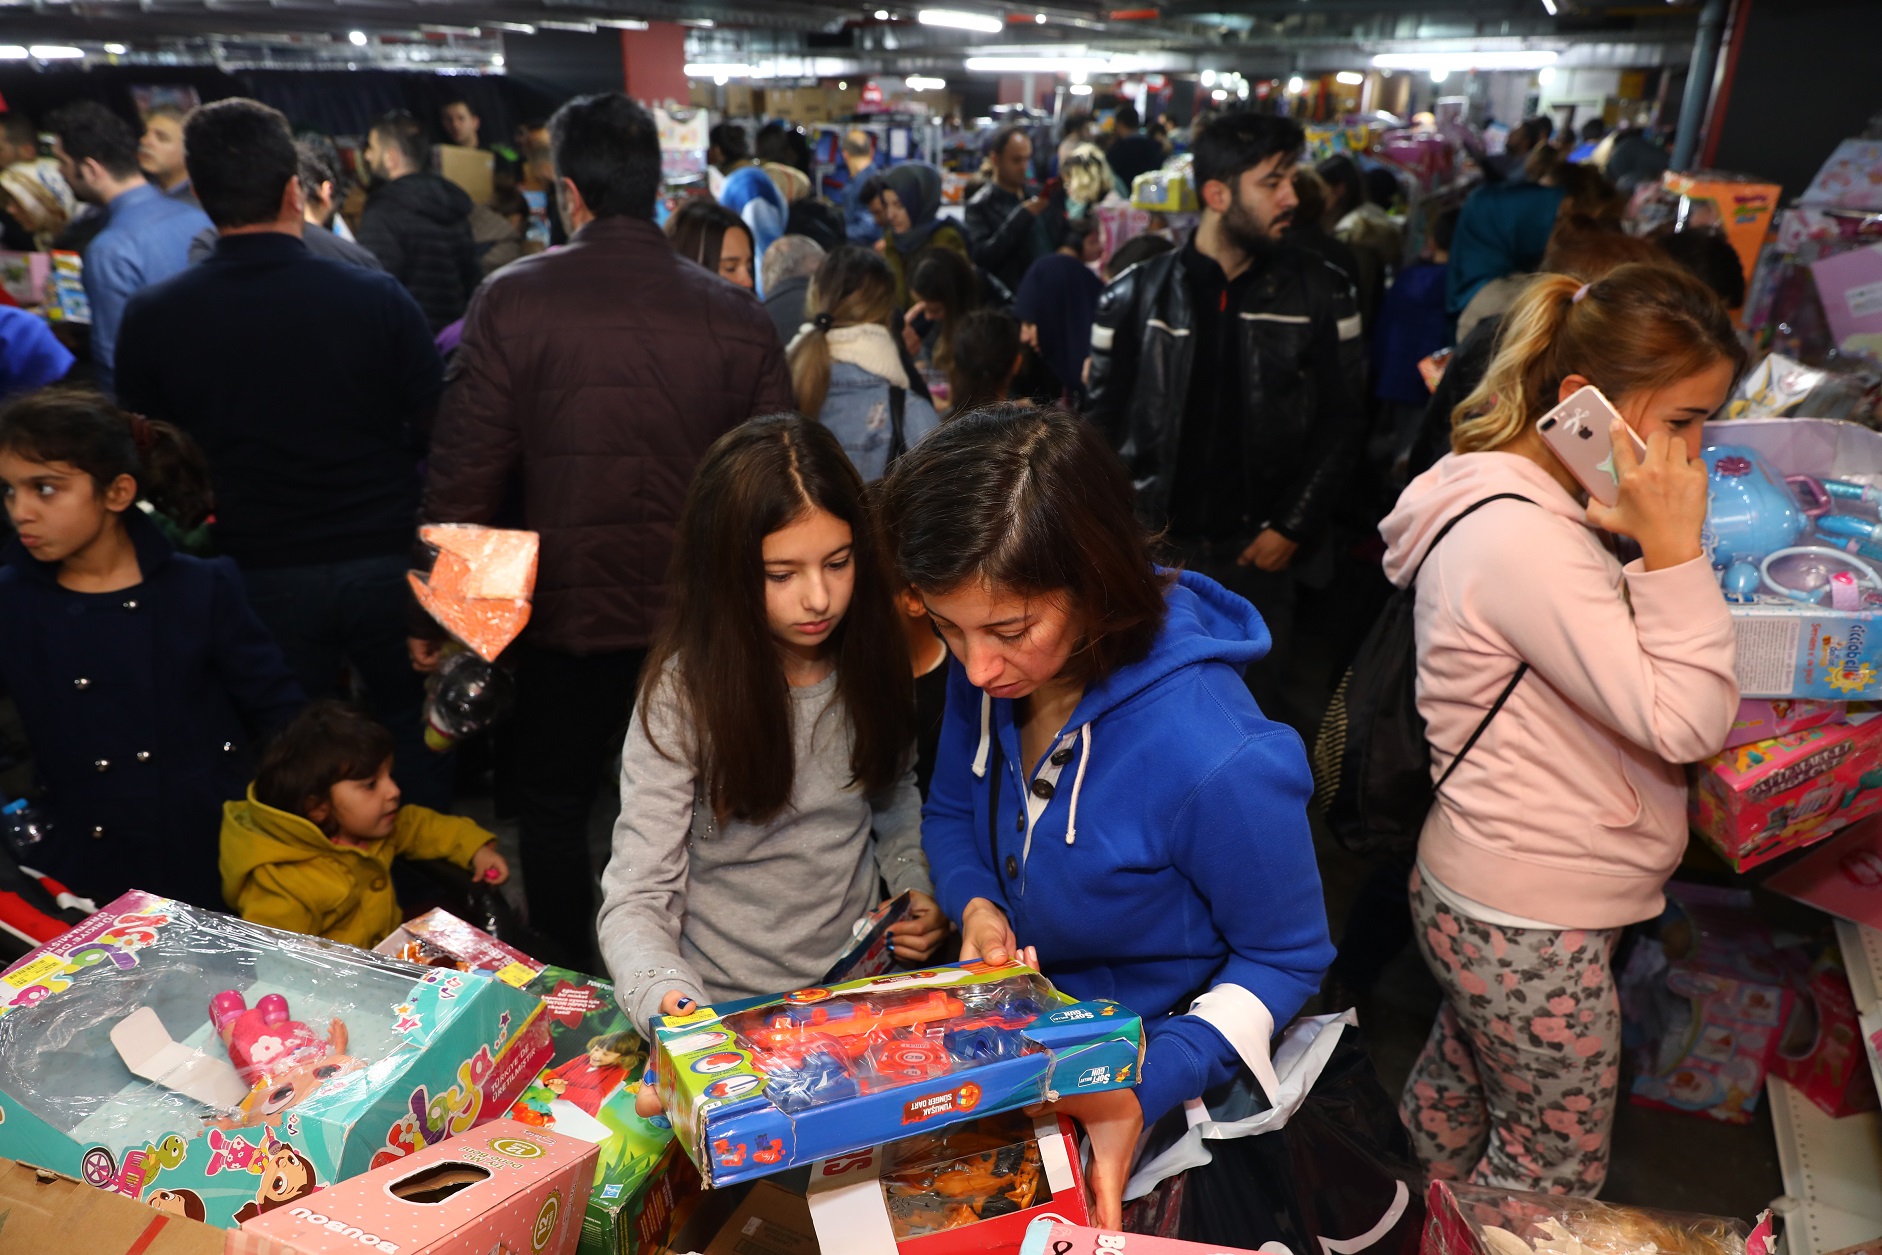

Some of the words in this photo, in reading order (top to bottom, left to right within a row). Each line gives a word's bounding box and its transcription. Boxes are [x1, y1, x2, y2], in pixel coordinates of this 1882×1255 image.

[910, 1099, 927, 1110] DART
[928, 1093, 953, 1105] SÜNGER
[923, 1102, 953, 1116] YUMUŞAK
[505, 1146, 525, 1155] 12
[288, 1207, 401, 1254] BOUBOU
[537, 1214, 549, 1239] 12
